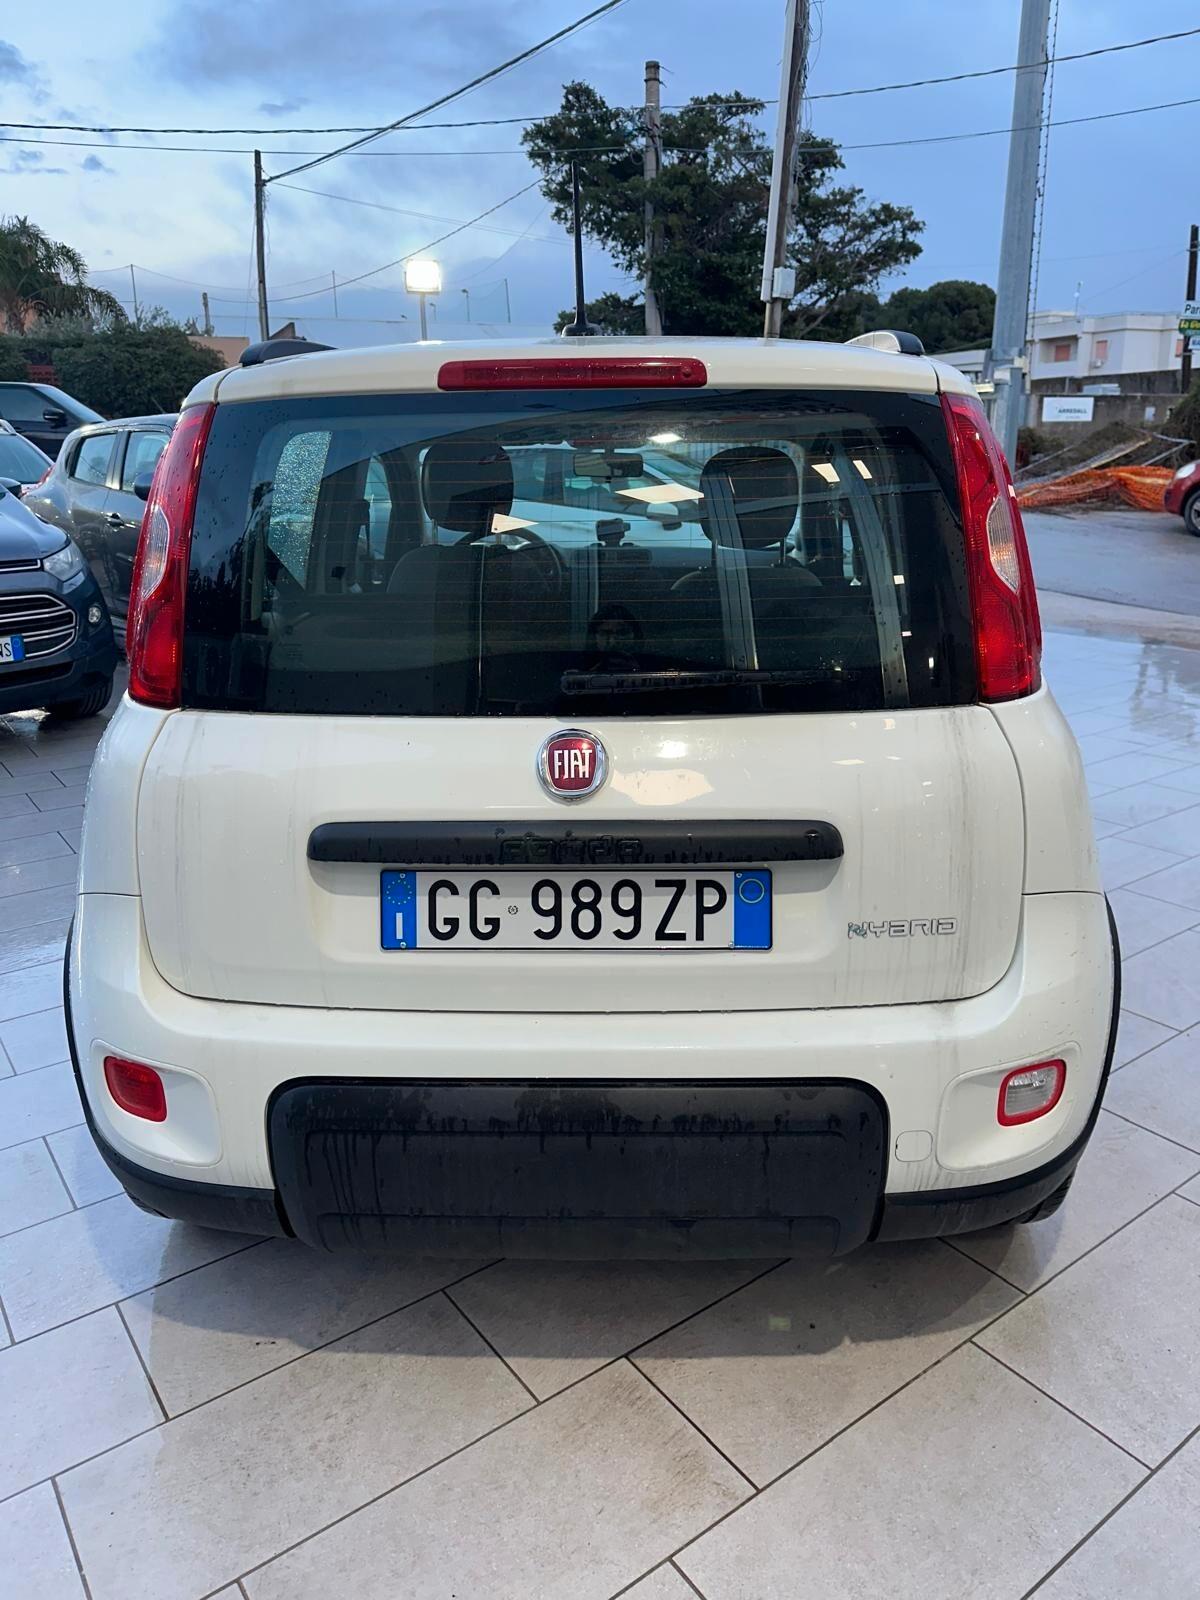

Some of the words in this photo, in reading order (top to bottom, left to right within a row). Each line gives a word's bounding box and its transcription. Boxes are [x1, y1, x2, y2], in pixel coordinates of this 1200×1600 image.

[553, 749, 593, 779] FIAT
[427, 879, 500, 941] GG
[531, 879, 728, 941] 989ZP
